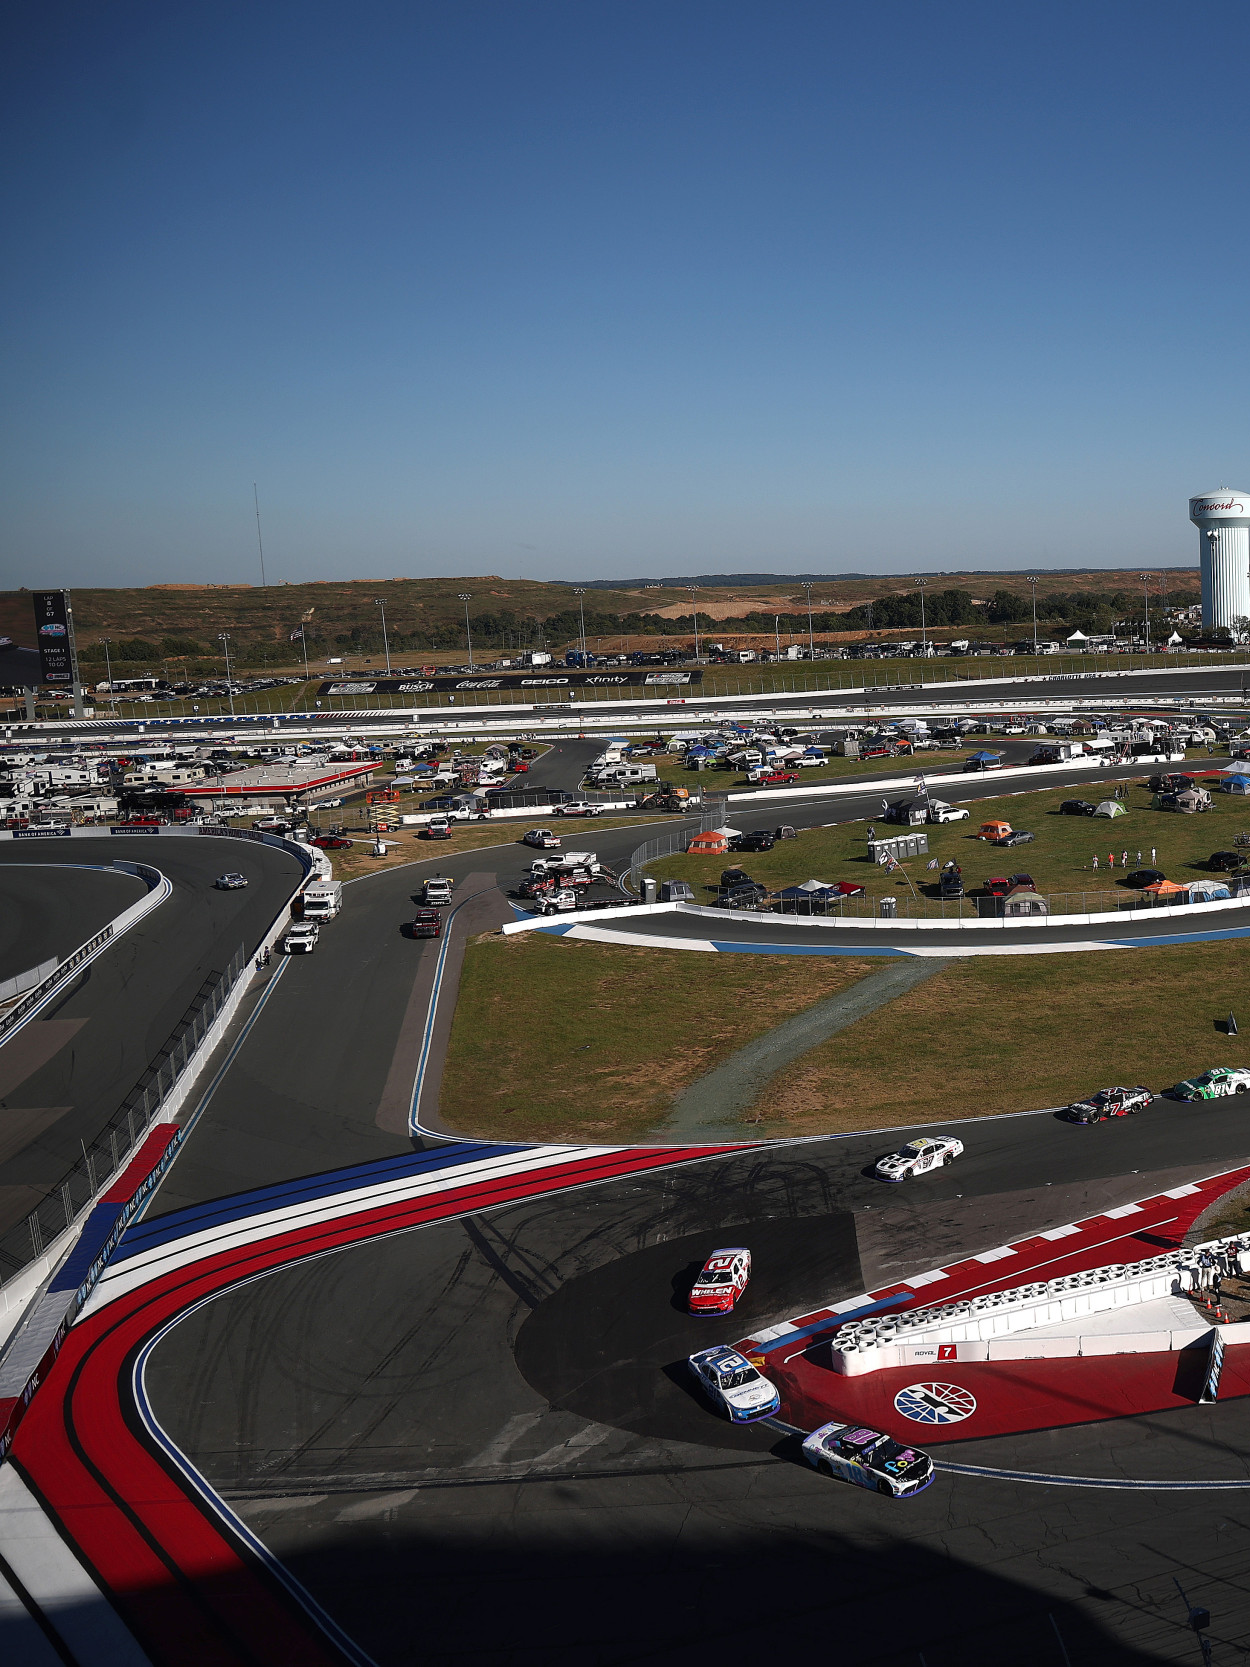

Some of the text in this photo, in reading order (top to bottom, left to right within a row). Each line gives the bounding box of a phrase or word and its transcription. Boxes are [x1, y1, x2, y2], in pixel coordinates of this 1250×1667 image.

[1191, 498, 1243, 516] Concord
[456, 680, 503, 689] Coca-Cola
[585, 676, 628, 684] xfinity
[398, 683, 434, 691] BUSCH
[1214, 1084, 1226, 1095] 81
[1110, 1102, 1120, 1116] 7
[691, 1287, 733, 1296] WHELEN
[943, 1347, 952, 1357] 7
